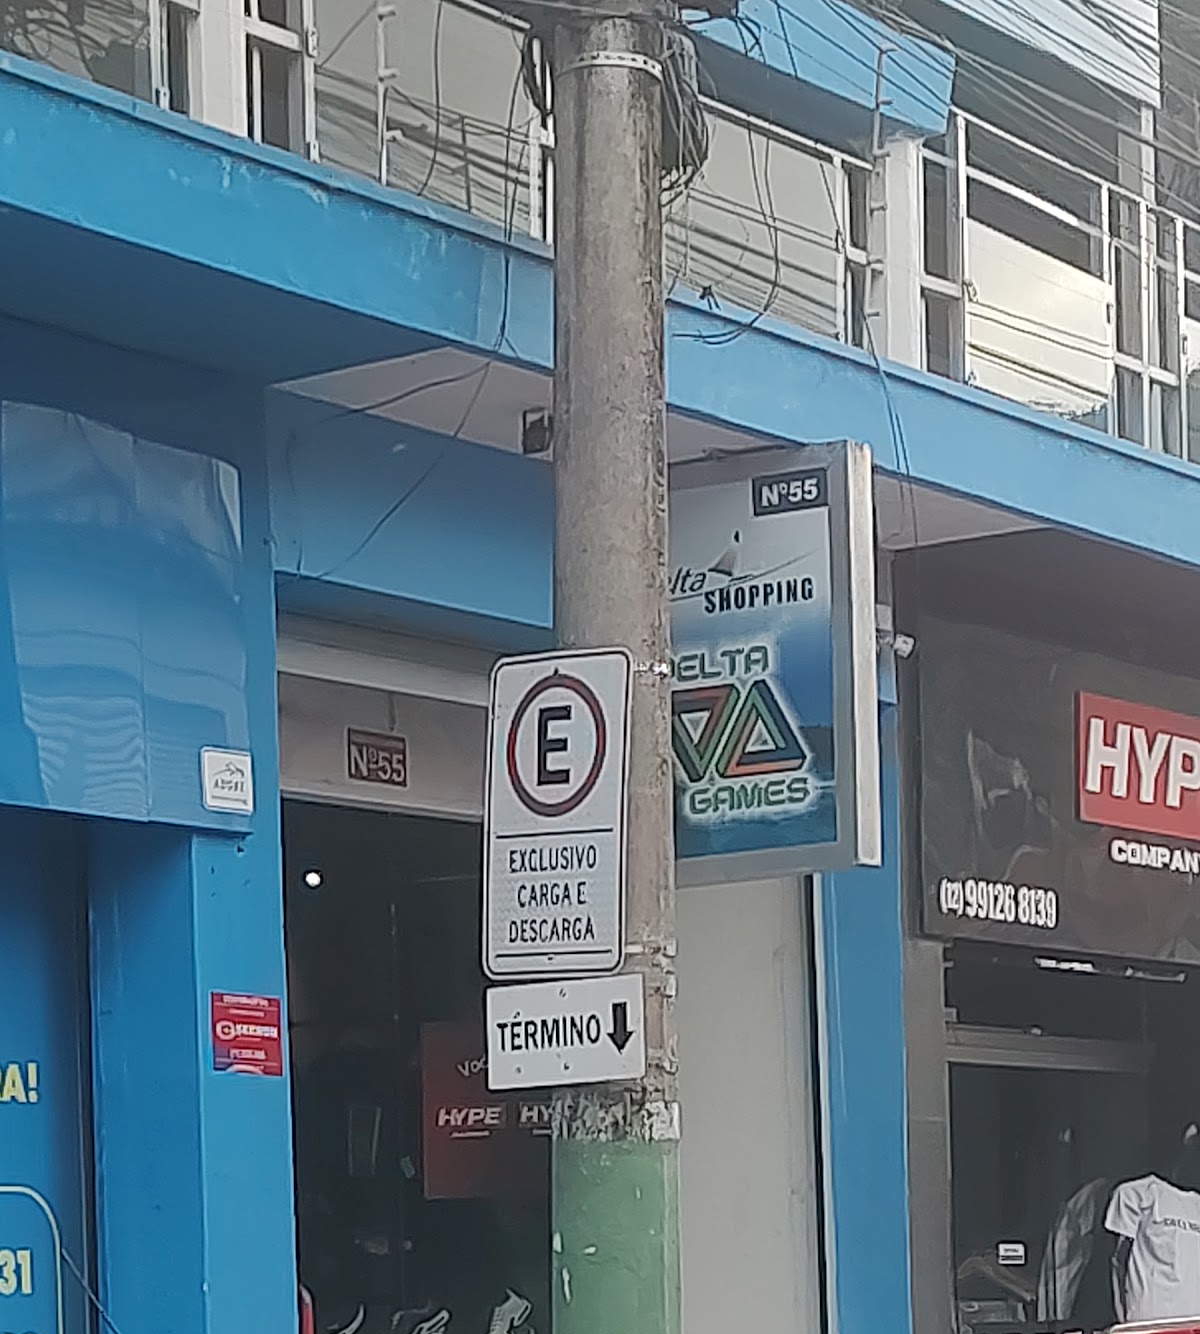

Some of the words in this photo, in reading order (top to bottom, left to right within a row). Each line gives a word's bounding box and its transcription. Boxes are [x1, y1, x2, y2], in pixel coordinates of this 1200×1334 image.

[669, 566, 707, 595] lta
[704, 577, 814, 614] SHOPPING
[536, 705, 572, 786] E
[689, 777, 810, 815] GAMES
[509, 844, 597, 873] EXCLUSIVO
[1110, 839, 1200, 875] COMPAN
[517, 882, 572, 908] CARGA
[577, 881, 587, 905] E
[964, 879, 1016, 923] 99126
[1017, 886, 1057, 929] 8139
[509, 914, 595, 943] DESCARGA
[496, 1011, 601, 1051] TÉRMINO
[0, 1063, 38, 1103] A!
[438, 1106, 502, 1126] HYPE
[521, 1105, 552, 1124] HY
